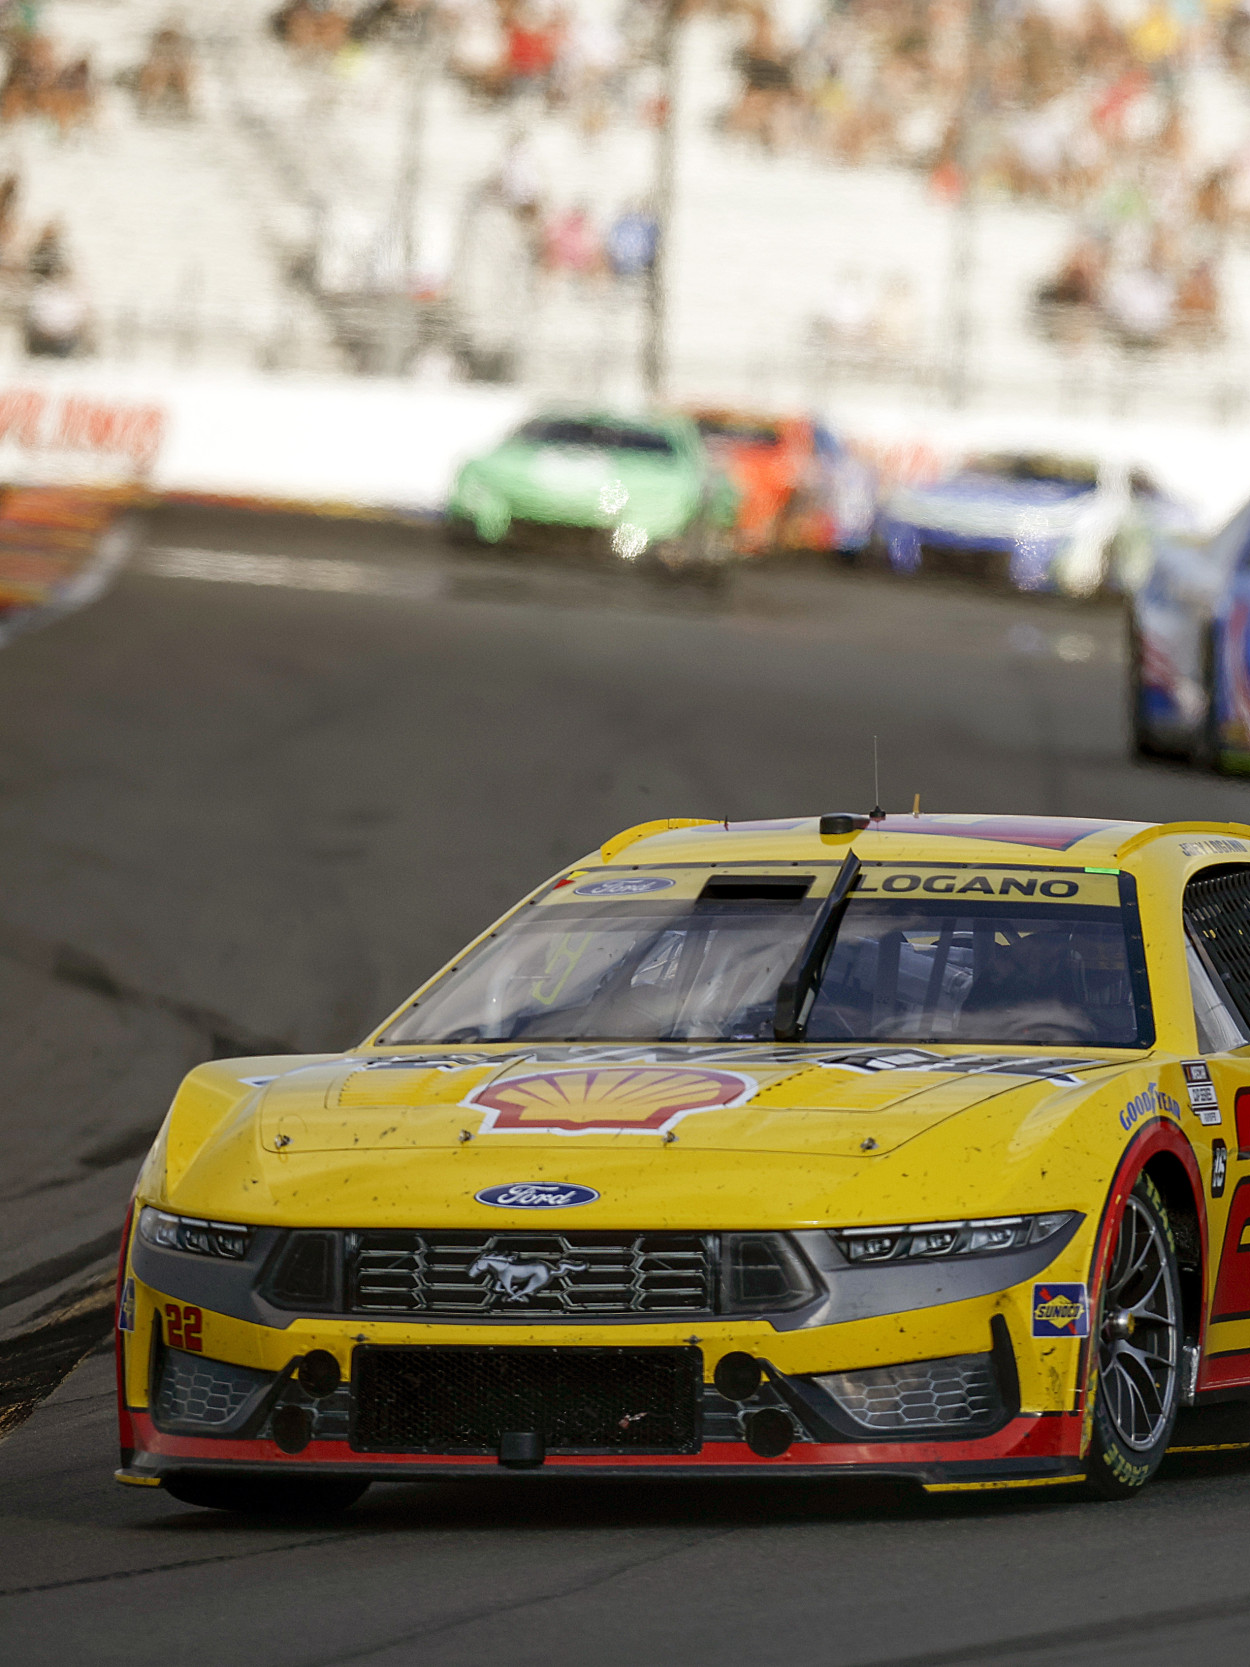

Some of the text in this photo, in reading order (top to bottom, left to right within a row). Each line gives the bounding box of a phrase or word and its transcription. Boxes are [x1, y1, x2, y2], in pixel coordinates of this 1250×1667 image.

[590, 879, 657, 894] Ford
[861, 873, 1079, 898] LOGANO
[497, 1184, 577, 1205] Ford
[1037, 1305, 1081, 1319] SUNOCO
[165, 1303, 203, 1352] 22
